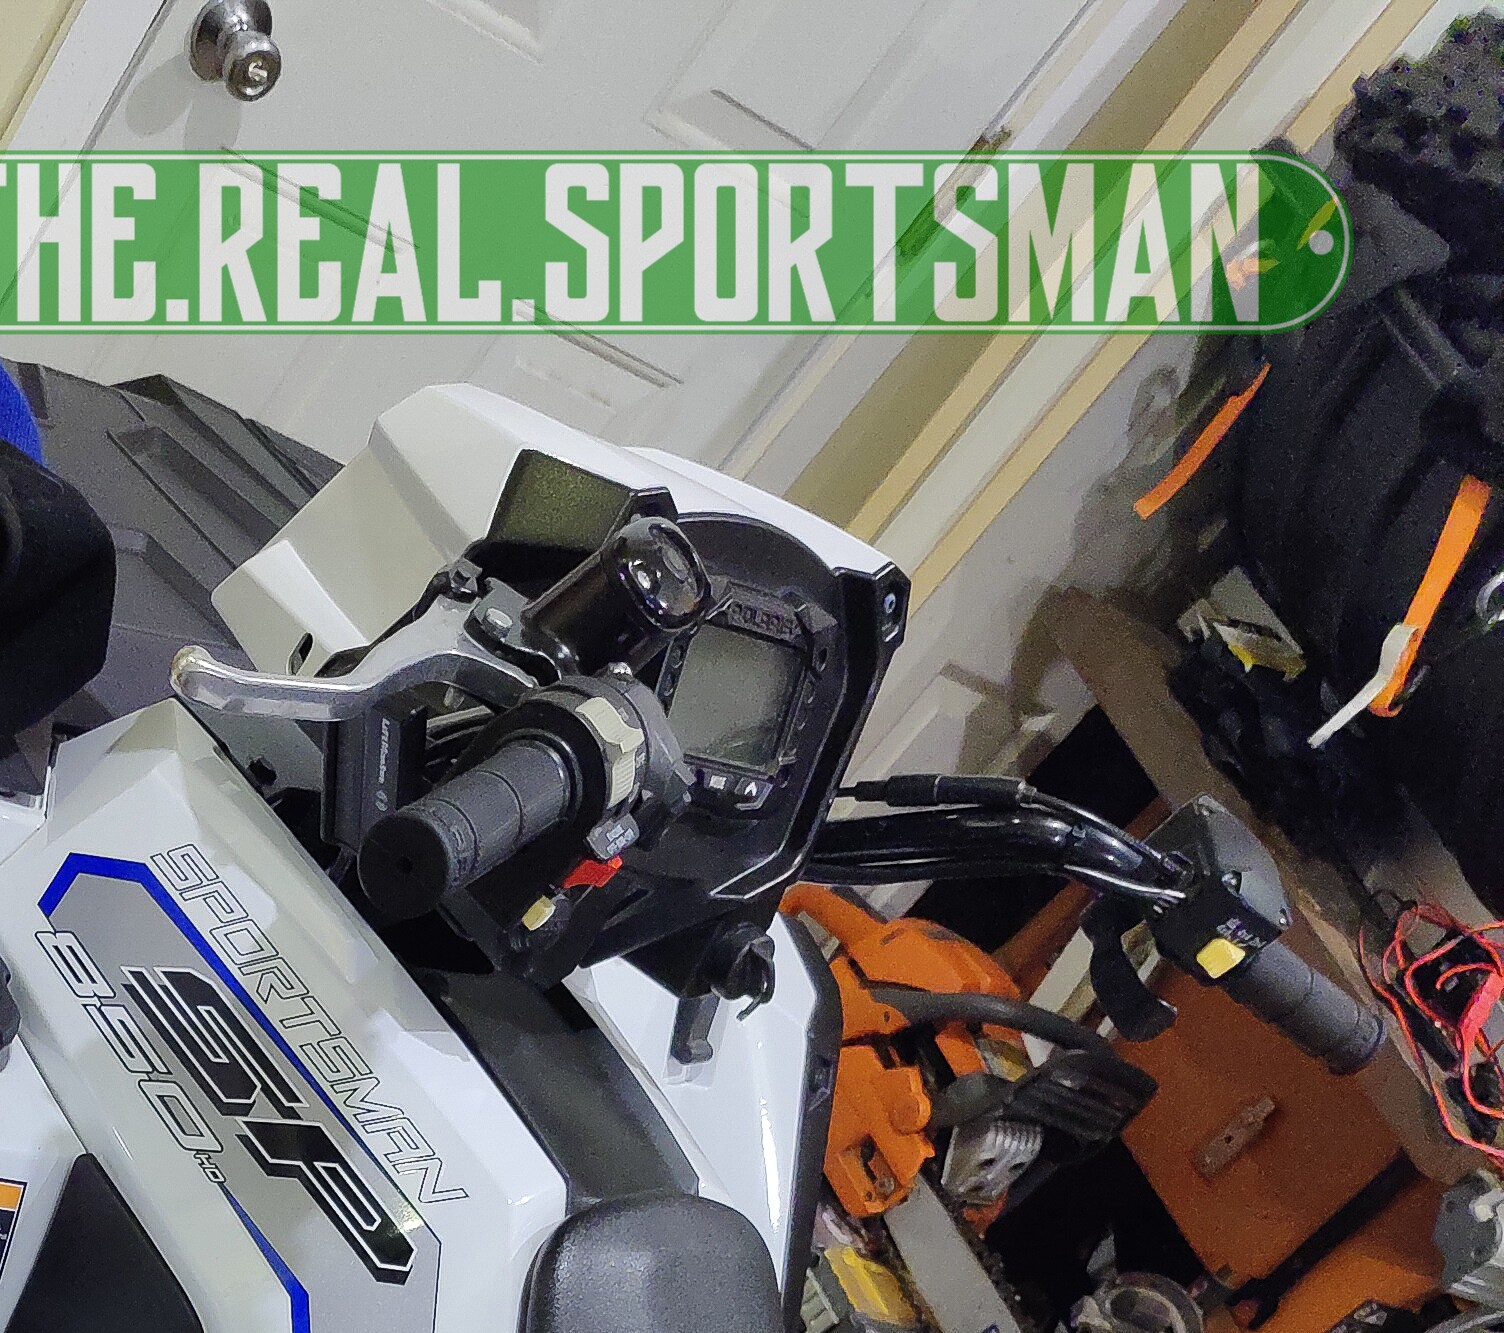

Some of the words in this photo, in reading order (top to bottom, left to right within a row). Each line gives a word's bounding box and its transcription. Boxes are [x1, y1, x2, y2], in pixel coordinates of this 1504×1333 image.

[35, 931, 223, 1153] 850
[120, 966, 417, 1286] SP
[150, 844, 469, 1203] SPORTSMAN
